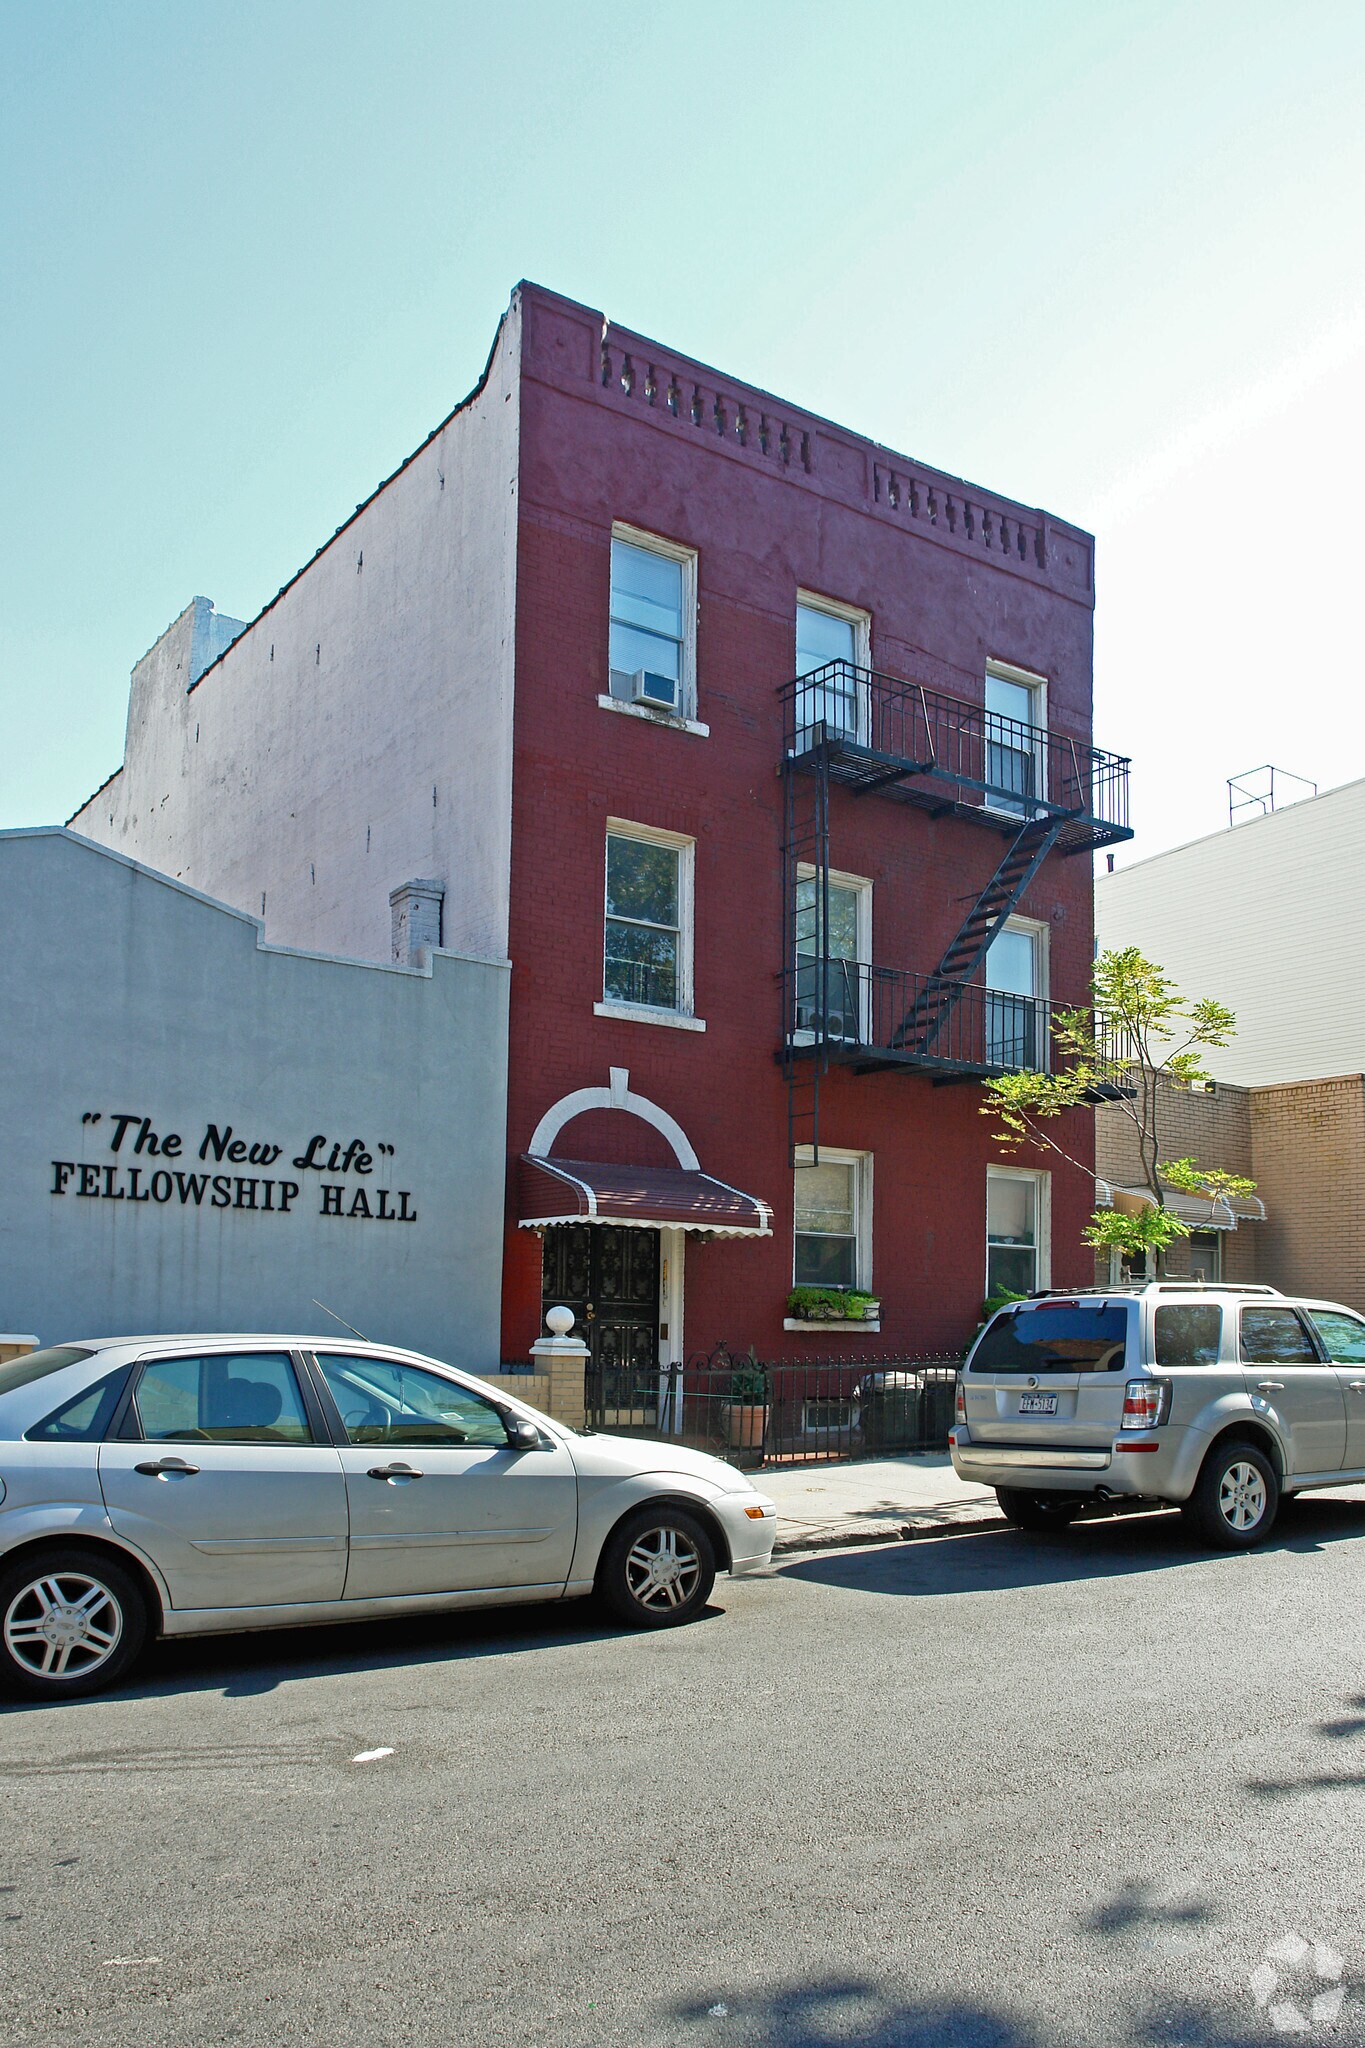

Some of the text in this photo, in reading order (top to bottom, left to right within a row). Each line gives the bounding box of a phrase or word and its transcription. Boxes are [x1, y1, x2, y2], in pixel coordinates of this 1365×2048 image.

[198, 1123, 283, 1166] New
[50, 1160, 417, 1221] FELLOWSHIP HALL
